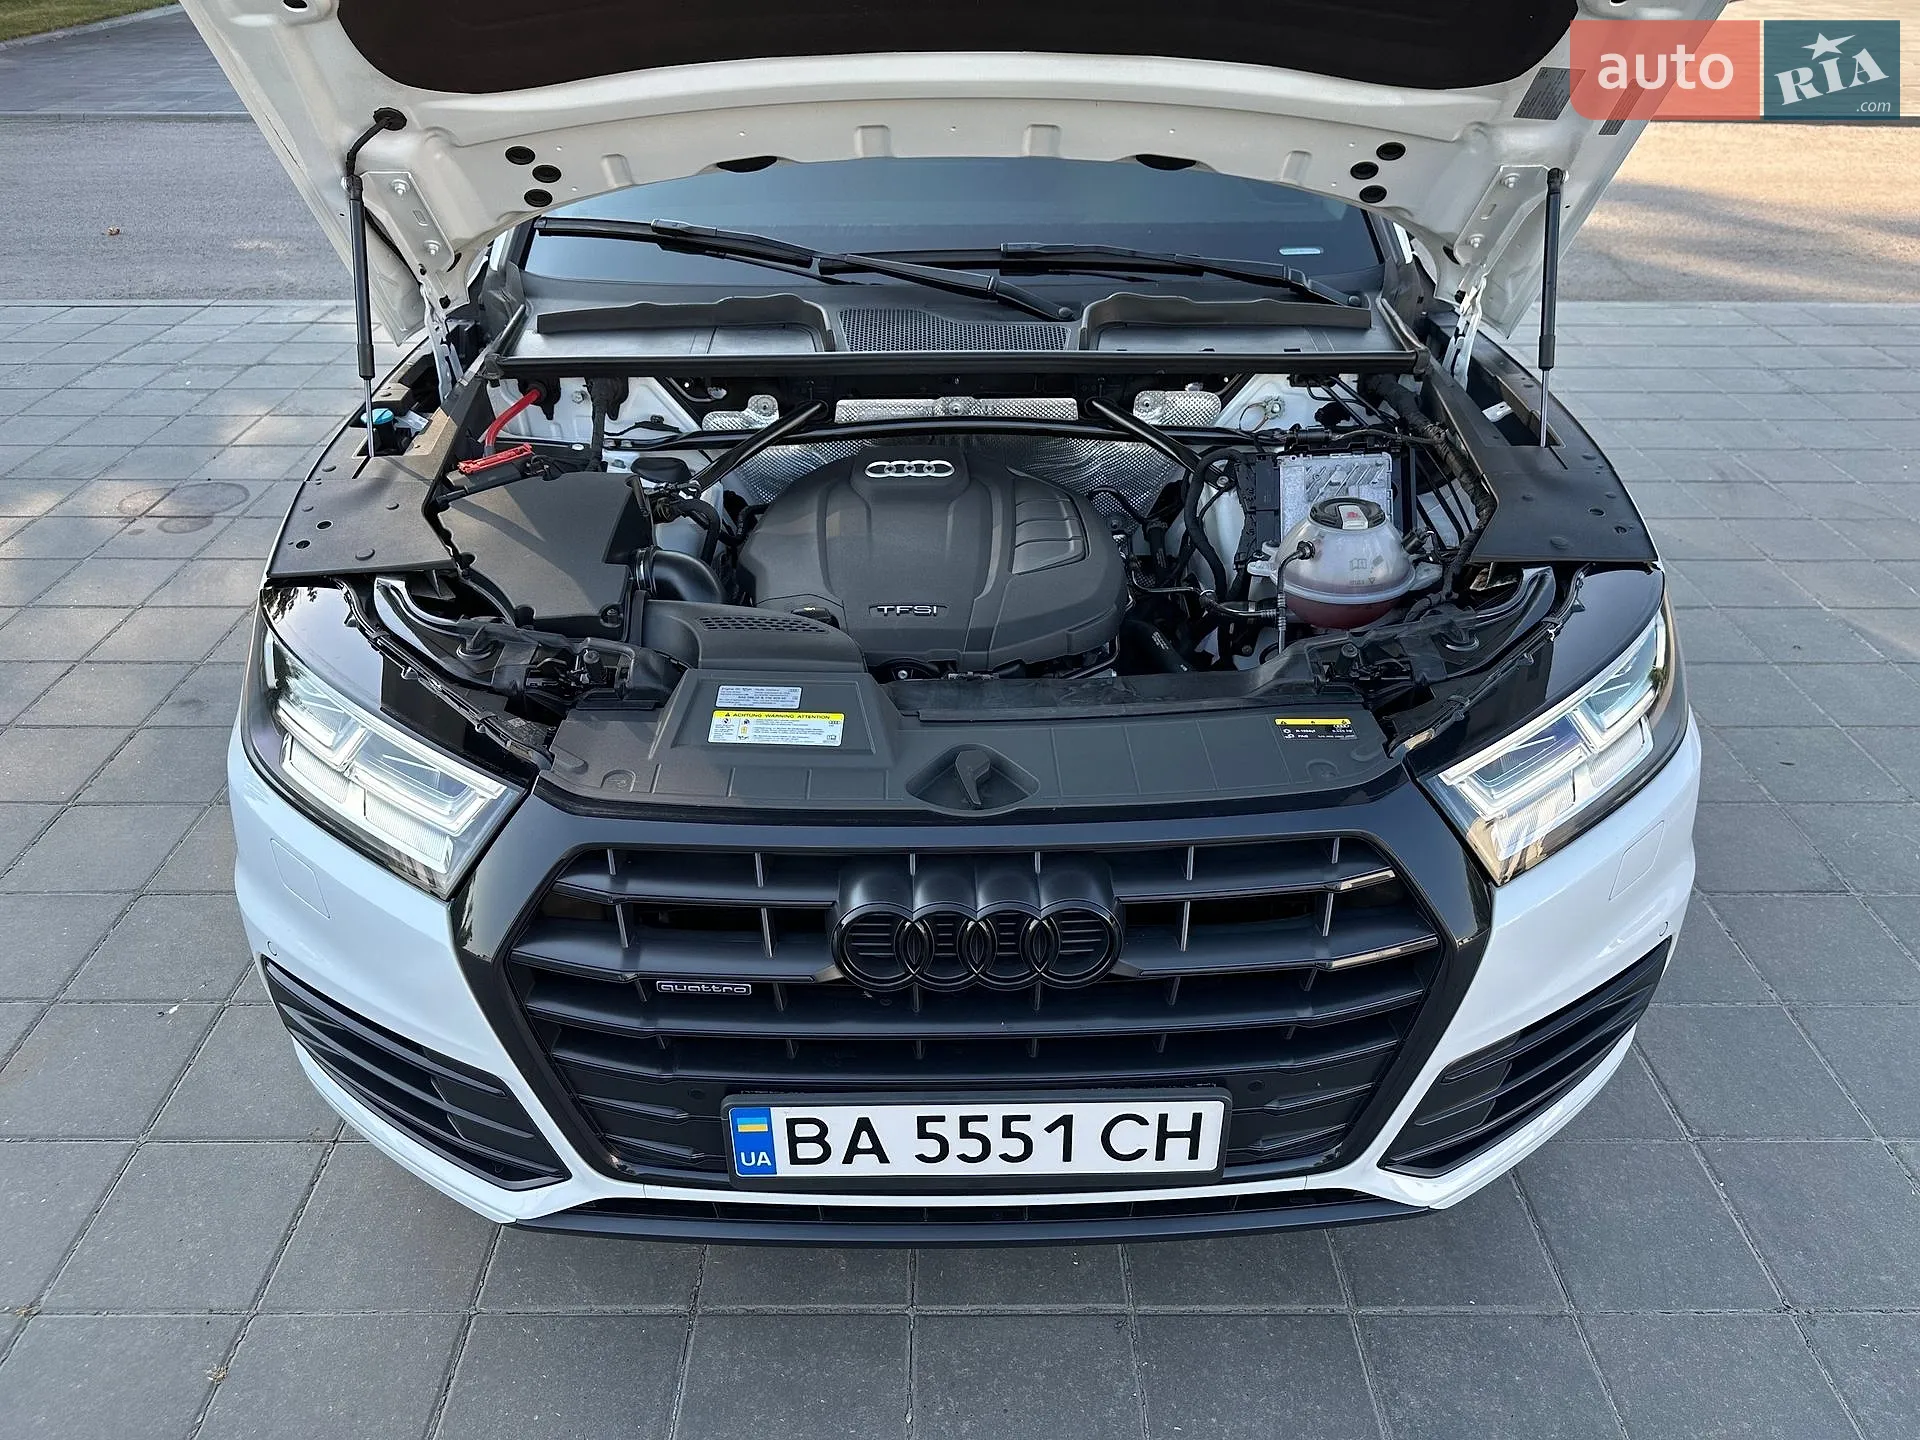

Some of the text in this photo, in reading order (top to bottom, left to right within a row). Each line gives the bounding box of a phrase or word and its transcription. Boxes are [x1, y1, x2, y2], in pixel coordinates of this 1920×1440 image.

[877, 605, 937, 616] TFSI
[660, 984, 747, 993] quattro
[741, 1112, 1204, 1167] UA BA 5551 CH
